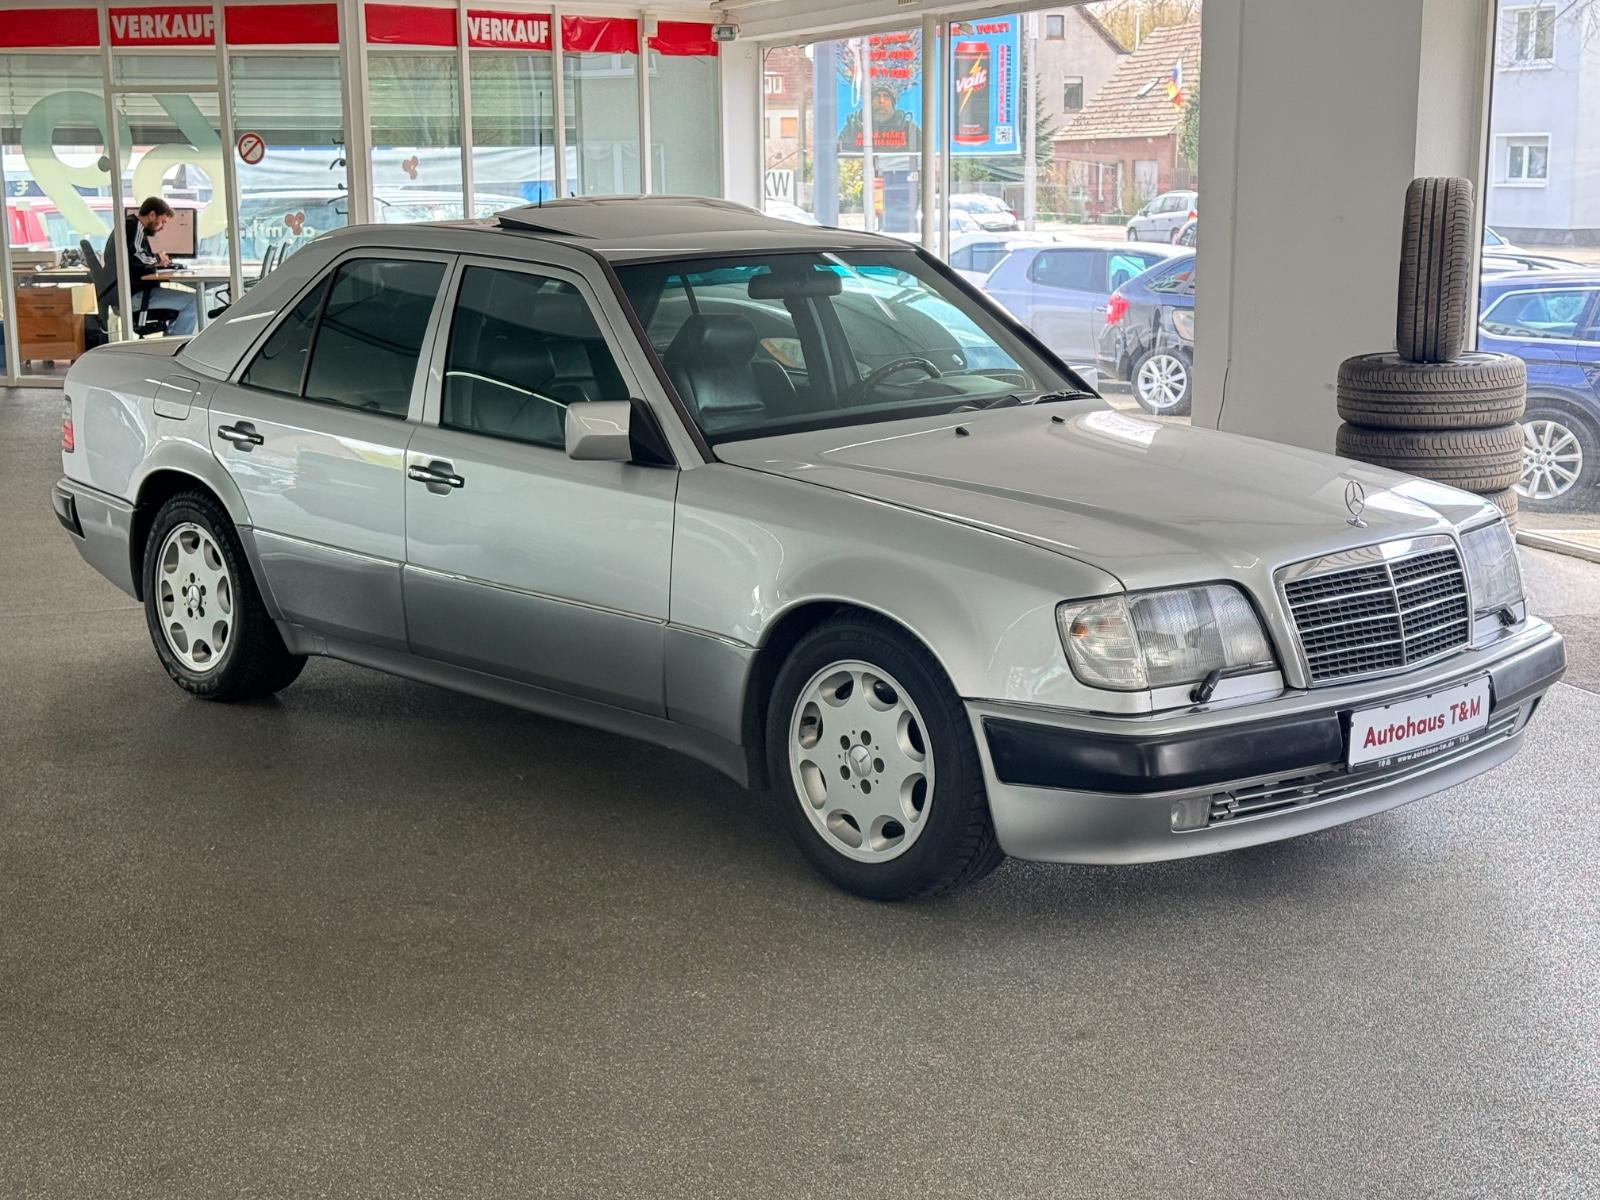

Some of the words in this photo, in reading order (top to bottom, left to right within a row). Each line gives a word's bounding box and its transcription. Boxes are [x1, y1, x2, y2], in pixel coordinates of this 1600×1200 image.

[111, 13, 214, 39] VERKAUF
[467, 16, 549, 43] VERKAUF
[1363, 715, 1446, 749] Autohaus
[1449, 695, 1481, 725] T&M
